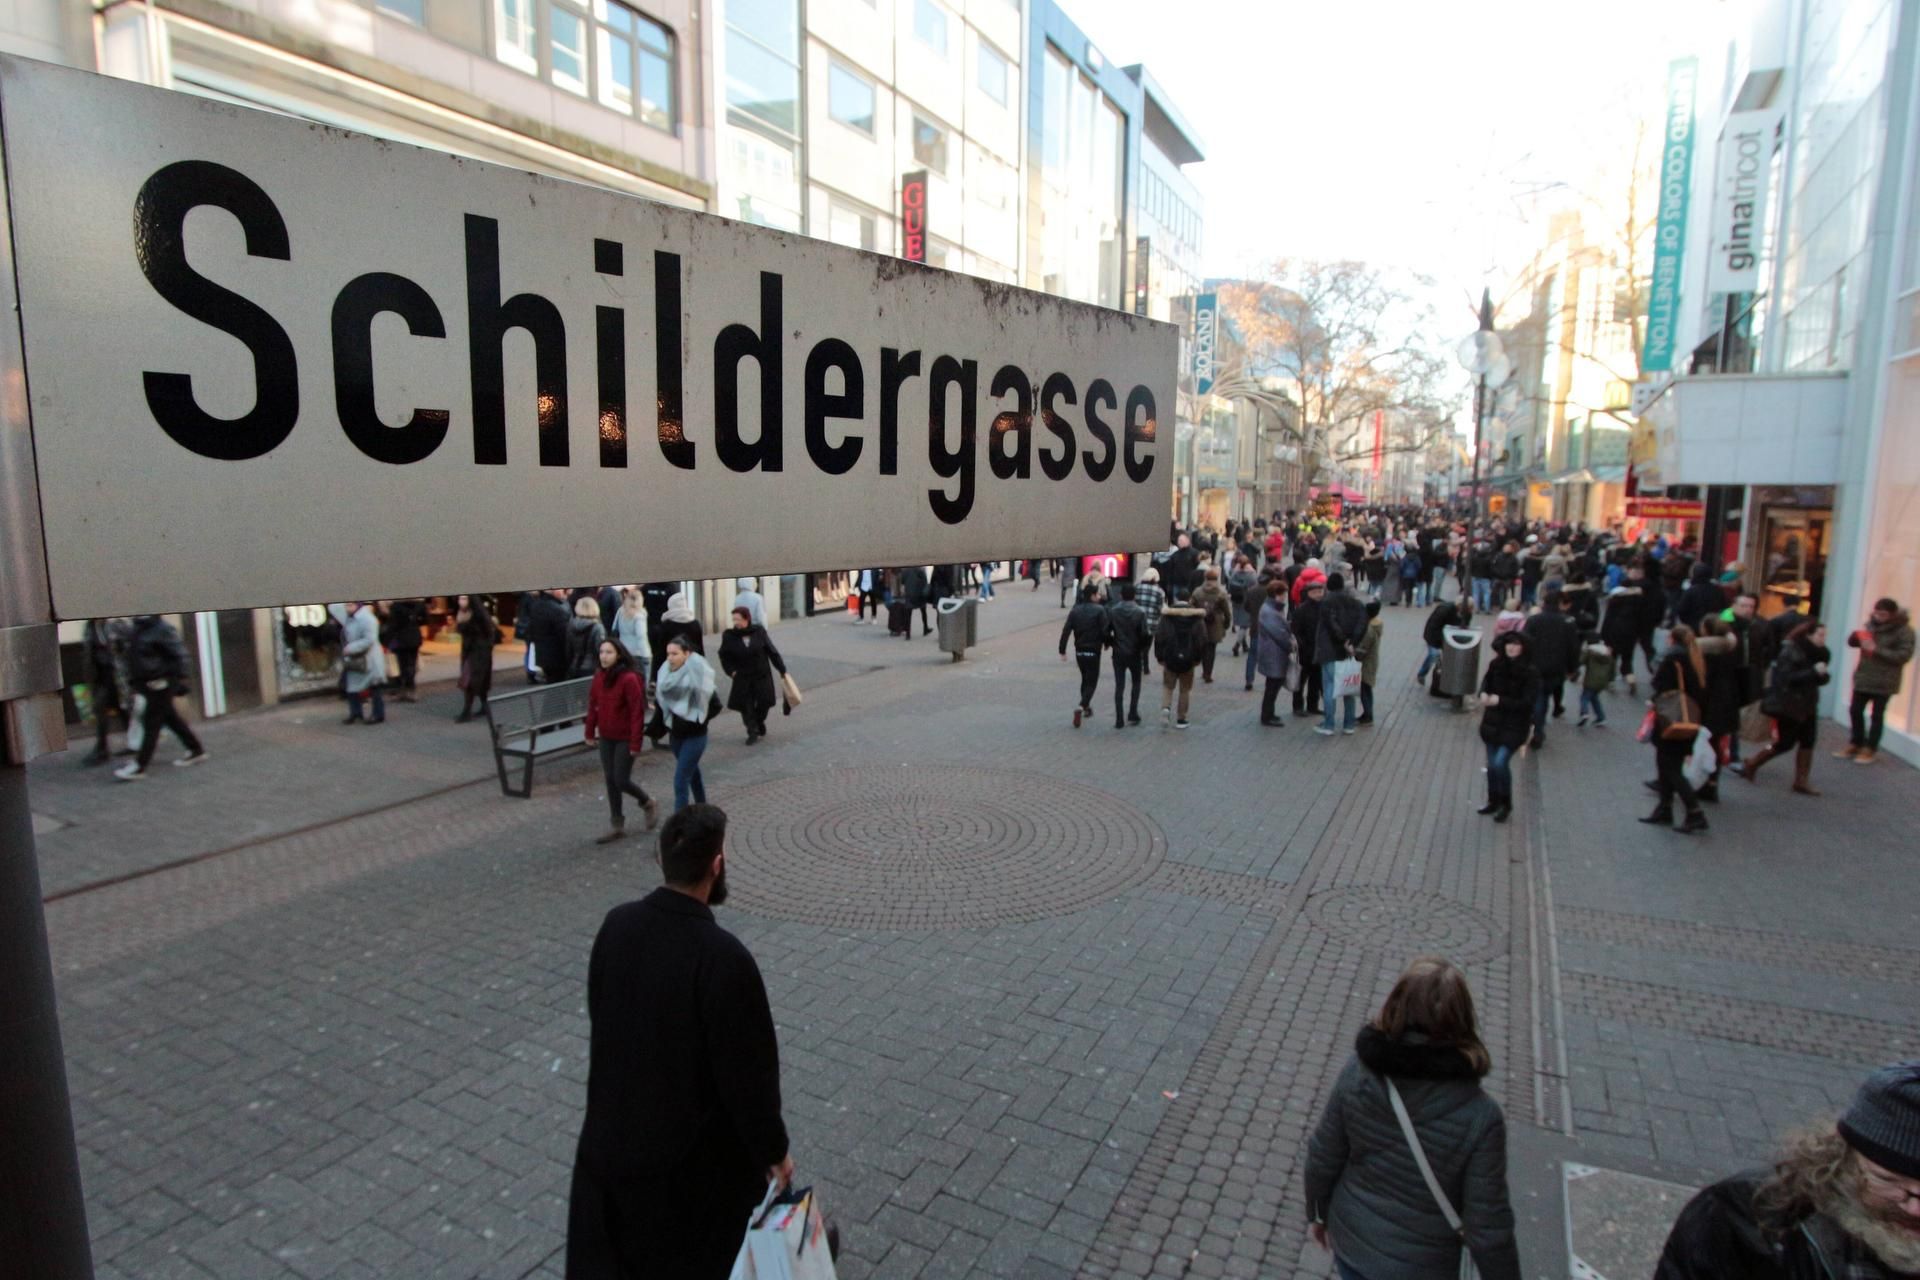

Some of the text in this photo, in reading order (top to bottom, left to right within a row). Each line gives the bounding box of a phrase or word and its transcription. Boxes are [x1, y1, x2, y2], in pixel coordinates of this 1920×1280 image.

[1663, 144, 1687, 221] COLORS
[1661, 224, 1679, 249] OF
[135, 159, 1156, 525] Schildergasse
[1651, 255, 1677, 357] BENETTON
